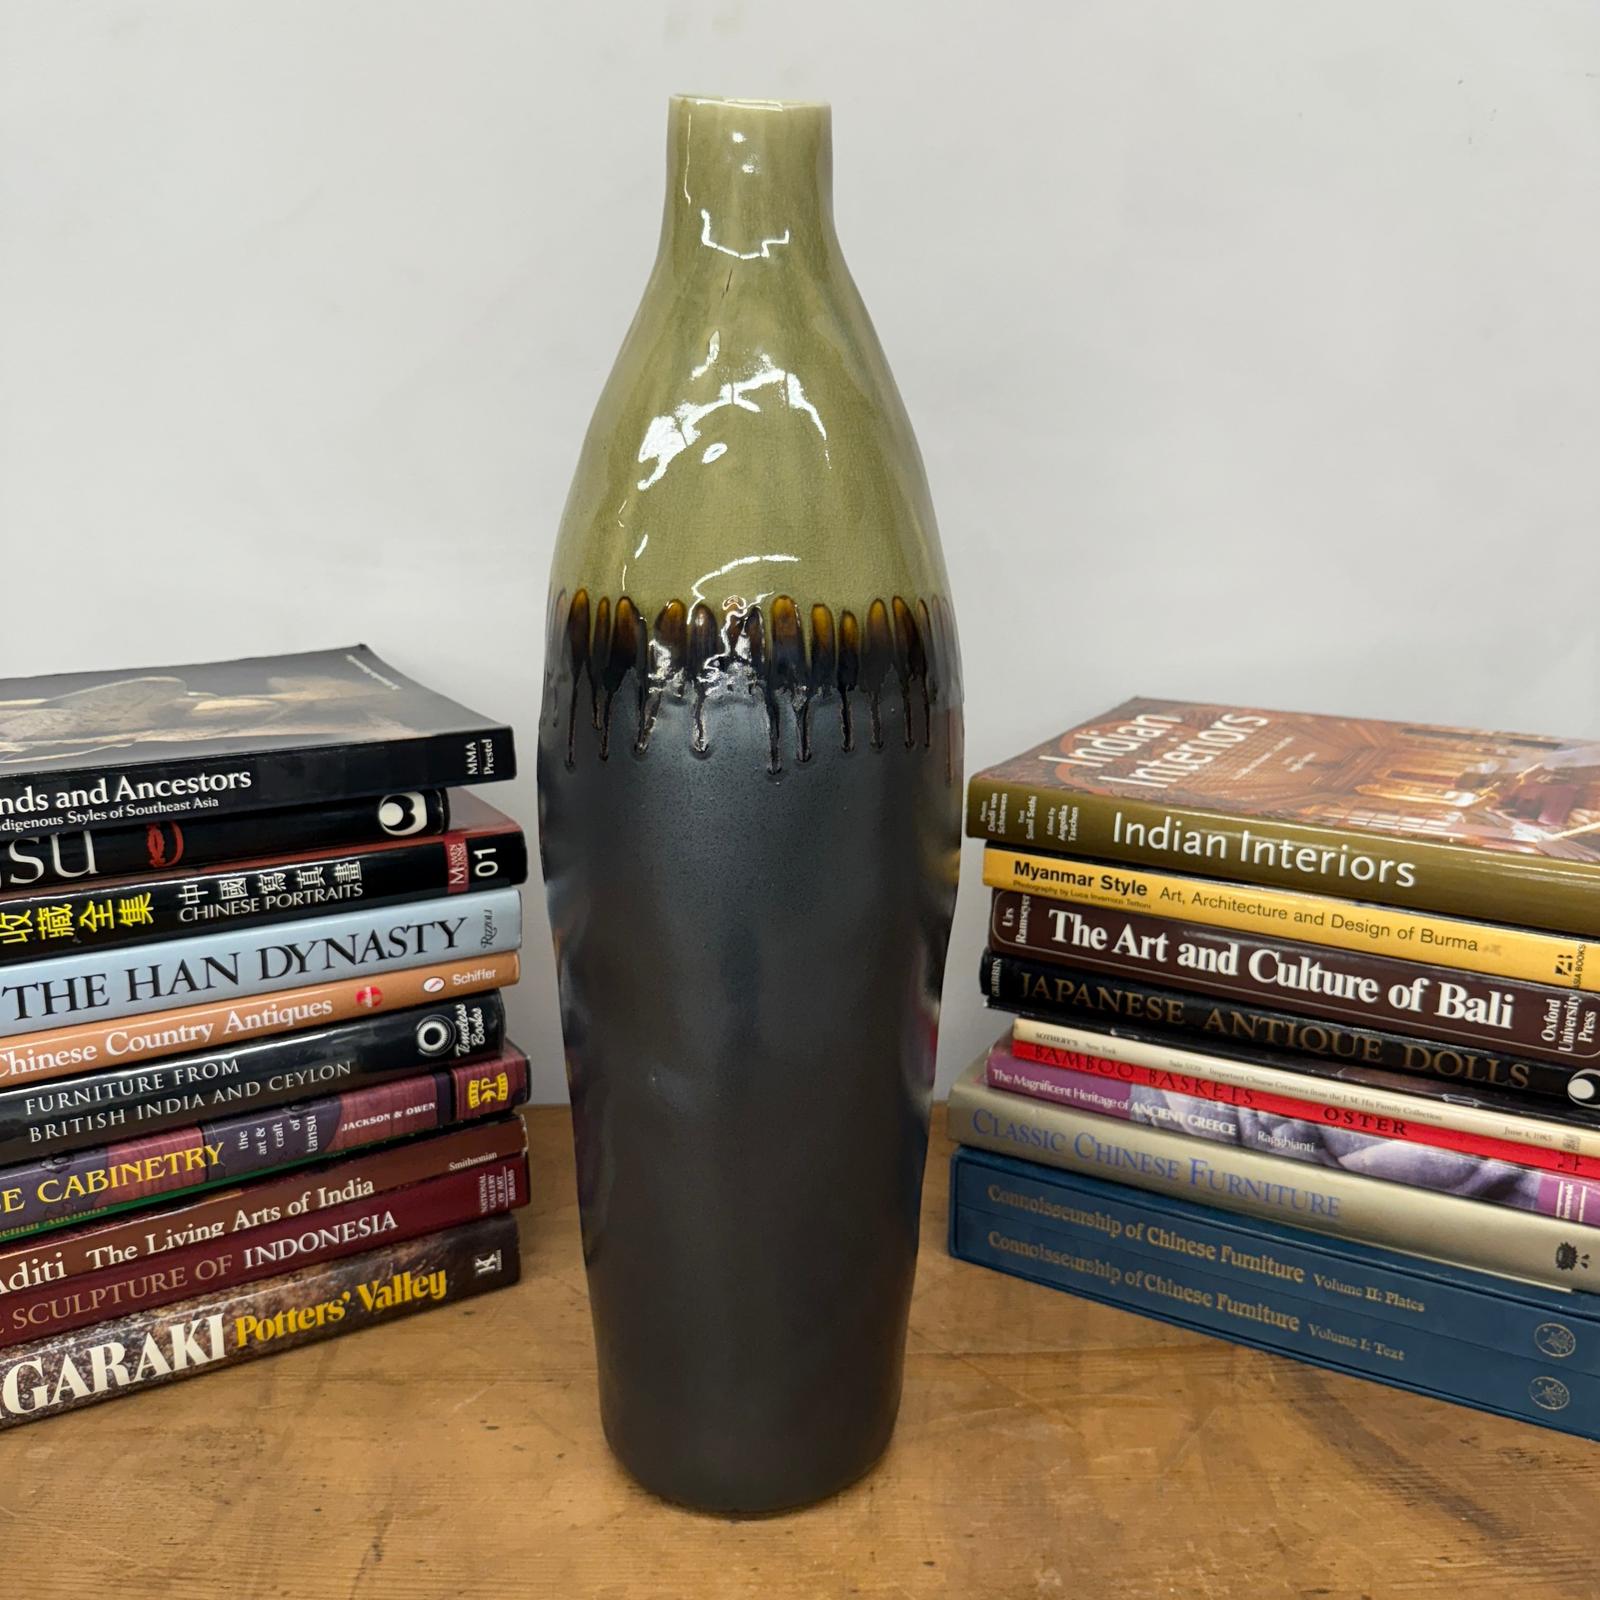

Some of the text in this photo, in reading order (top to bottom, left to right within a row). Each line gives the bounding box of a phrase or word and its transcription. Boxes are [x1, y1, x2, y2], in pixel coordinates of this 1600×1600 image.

[465, 742, 478, 775] MMA
[481, 738, 494, 775] Prestel
[1039, 713, 1183, 768] Indian
[1099, 713, 1271, 788] Interiors
[55, 778, 110, 809] and
[114, 771, 252, 801] Ancestors
[0, 797, 219, 834] digenous Styles of Southeast Asia
[474, 848, 498, 877] 01
[1114, 811, 1417, 888] Indian Interiors
[1014, 860, 1147, 896] Myanmar Style
[179, 883, 363, 922] CHINESE PORTRAITS
[1159, 886, 1479, 952] Art, Architecture and Design of Burma
[2, 917, 467, 1020] THE HAN DYNASTY
[453, 968, 497, 985] Schiffer
[1048, 909, 1515, 1029] The Art and Culture of Bali
[1575, 943, 1586, 972] BOOKS
[106, 1023, 213, 1052] Country
[223, 1000, 333, 1035] Antiques
[1020, 972, 1530, 1089] JAPANESE ANTIQUE DOLLS
[1541, 999, 1561, 1042] Oxford
[1558, 992, 1582, 1052] University
[1578, 1010, 1597, 1043] Press
[25, 1059, 240, 1115] FURNITURE FROM
[1034, 1044, 1254, 1105] BAMBOO BASKETS
[29, 1062, 351, 1143] BRITISH INDIA AND CEYLON
[290, 1119, 300, 1131] of
[341, 1102, 435, 1132] JACKSON & OWEN
[993, 1069, 1237, 1136] The Magnificent Heritage of ANCIENT GREECE
[1323, 1107, 1408, 1136] OSTER
[239, 1131, 248, 1150] the
[256, 1127, 267, 1155] art &
[273, 1122, 284, 1148] craft
[307, 1116, 318, 1152] tansu
[1258, 1130, 1315, 1153] Ragghianti
[0, 1143, 224, 1213] E CABINETRY
[448, 1152, 497, 1171] Smithsonian
[971, 1108, 1342, 1219] CLASSIC CHINESE FURNITURE
[86, 1244, 138, 1270] The
[145, 1221, 225, 1255] Living
[232, 1207, 281, 1232] Arts
[288, 1191, 311, 1216] of
[318, 1177, 375, 1208] India
[12, 1210, 399, 1329] SCULPTURE OF INDONESIA
[988, 1183, 1122, 1239] Connoisseurship
[1125, 1223, 1145, 1241] of
[1147, 1227, 1217, 1261] Chinese
[1220, 1244, 1304, 1283] Furniture
[1313, 1273, 1362, 1297] Volume
[1384, 1291, 1425, 1313] Plates
[988, 1230, 1122, 1285] Connoisseurship
[1124, 1271, 1144, 1288] of
[1144, 1273, 1213, 1307] Chinese
[1216, 1292, 1300, 1332] Furniture
[1308, 1323, 1357, 1348] Volume
[1374, 1341, 1405, 1361] Text
[0, 1313, 227, 1419] GARAKI
[357, 1270, 447, 1312] Valley
